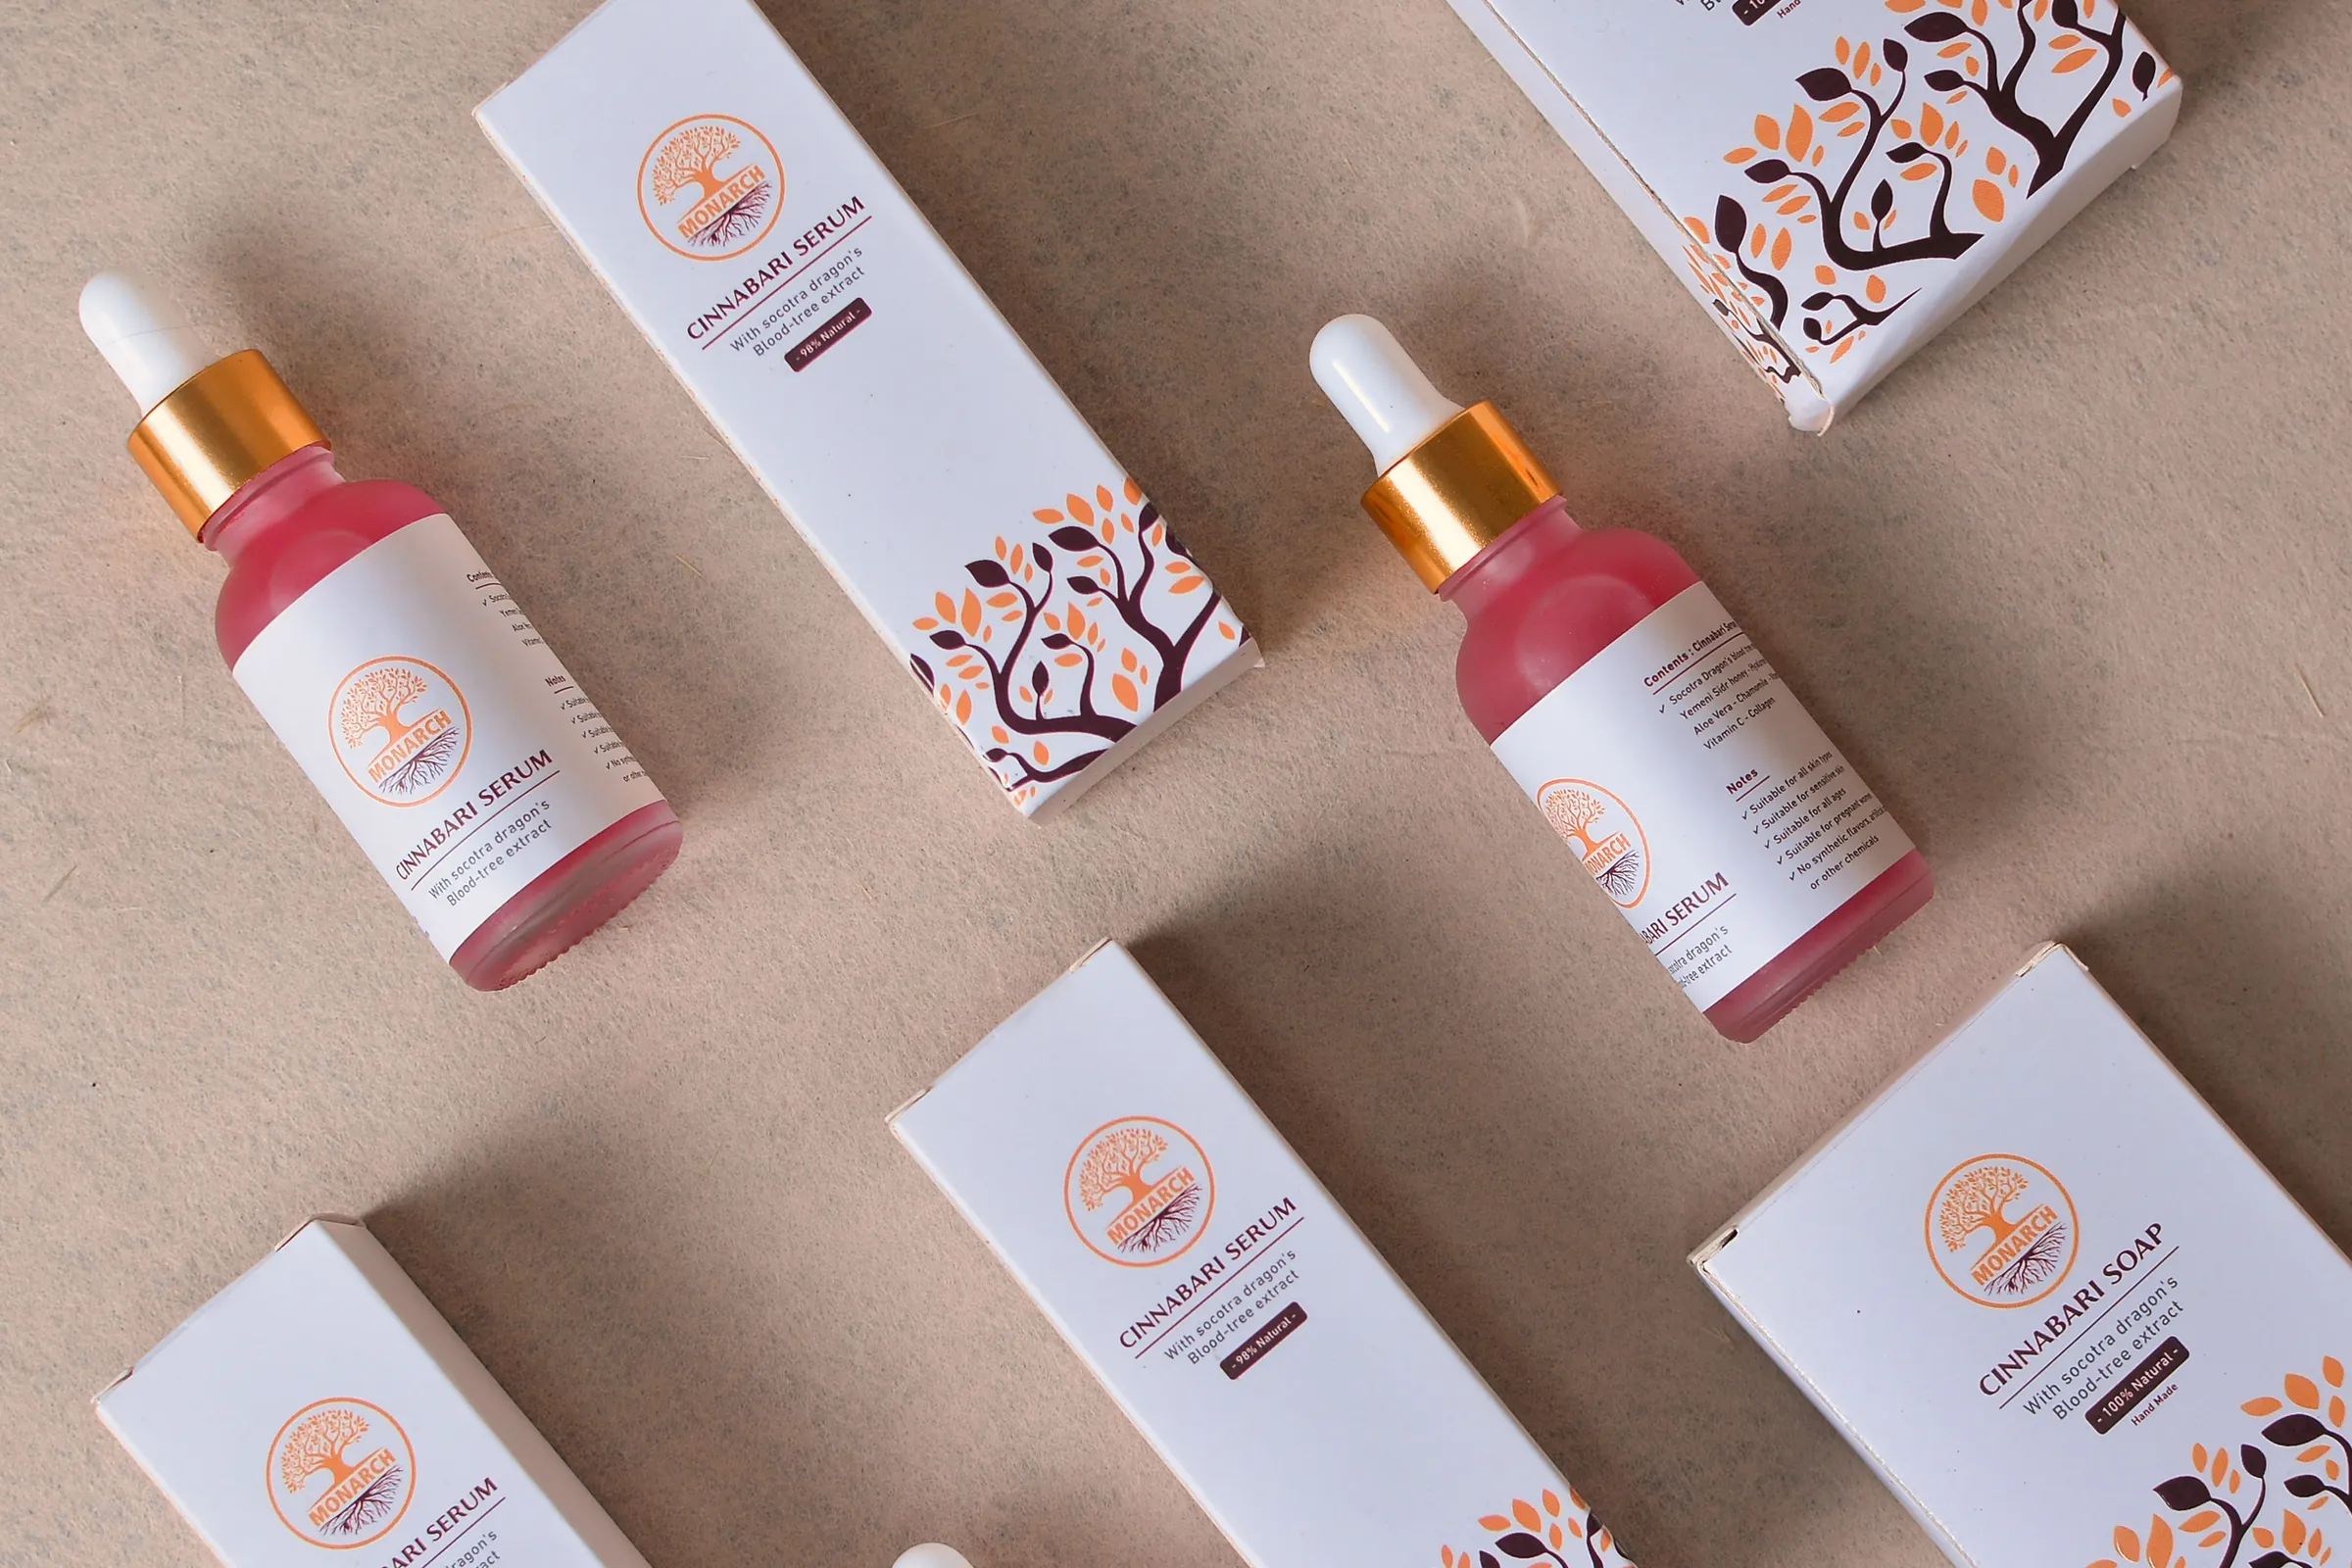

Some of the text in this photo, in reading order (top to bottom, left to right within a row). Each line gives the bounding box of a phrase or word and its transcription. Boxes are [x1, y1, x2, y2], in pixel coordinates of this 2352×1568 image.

[677, 165, 766, 238] MONARCH
[687, 196, 864, 339] CINNABARI SERUM
[730, 247, 862, 352] With socotra dragon's
[753, 266, 864, 356] Blood-tree extract
[800, 337, 822, 357] 98%
[820, 312, 856, 341] Natural
[1643, 651, 1690, 687] Contents
[1692, 623, 1727, 652] Cinnabari
[1669, 680, 1703, 705] Socotra
[1701, 658, 1733, 681] Dragon's
[1680, 693, 1713, 719] Yemeni
[1711, 680, 1729, 698] Sidr
[1728, 668, 1749, 686] honey
[1693, 717, 1714, 736] Aloe
[1712, 704, 1734, 719] Vera
[1703, 724, 1739, 750] Vitamin
[1736, 716, 1744, 726] C
[1747, 696, 1776, 718] Collagen
[368, 709, 453, 783] MONARCH
[1726, 768, 1758, 795] Notes
[1749, 786, 1787, 814] Suitable
[1785, 775, 1797, 788] for
[1798, 766, 1809, 779] all
[1808, 758, 1822, 772] skin
[1761, 800, 1798, 829] Suitable
[1796, 789, 1810, 802] for
[396, 749, 553, 880] CINNABARI SERUM
[1773, 788, 1846, 845] Suitable for all ages
[1785, 830, 1822, 859] Suitable
[1820, 820, 1833, 832] for
[428, 801, 550, 900] With socotra dragon's
[447, 818, 552, 906] Blood-tree extract
[1585, 833, 1631, 875] ONARCH
[1796, 862, 1812, 875] No
[1811, 834, 1848, 864] synthetic
[1810, 835, 1880, 890] or other chemicals
[1665, 871, 1729, 926] SERUM
[1686, 926, 1728, 960] dragon's
[1697, 945, 1732, 974] extract
[1106, 1167, 1196, 1246] MONARCH
[1119, 1197, 1297, 1348] CINNABARI SERUM
[1971, 1205, 2058, 1286] MONARCH
[1164, 1250, 1296, 1360] With socotra dragon's
[1188, 1269, 1299, 1364] Blood-tree extract
[1979, 1223, 2163, 1396] CINNABARI SOAP
[1236, 1346, 1257, 1364] 98%
[1255, 1317, 1292, 1348] Natural
[2023, 1277, 2178, 1415] With socotra dragon's
[2052, 1300, 2183, 1420] Blood-tree extract
[2102, 1388, 2133, 1418] 100%
[2131, 1351, 2174, 1392] Natural
[2131, 1384, 2178, 1426] Hand Made
[309, 1448, 397, 1527] MONARCH
[426, 1477, 498, 1542] SERUM
